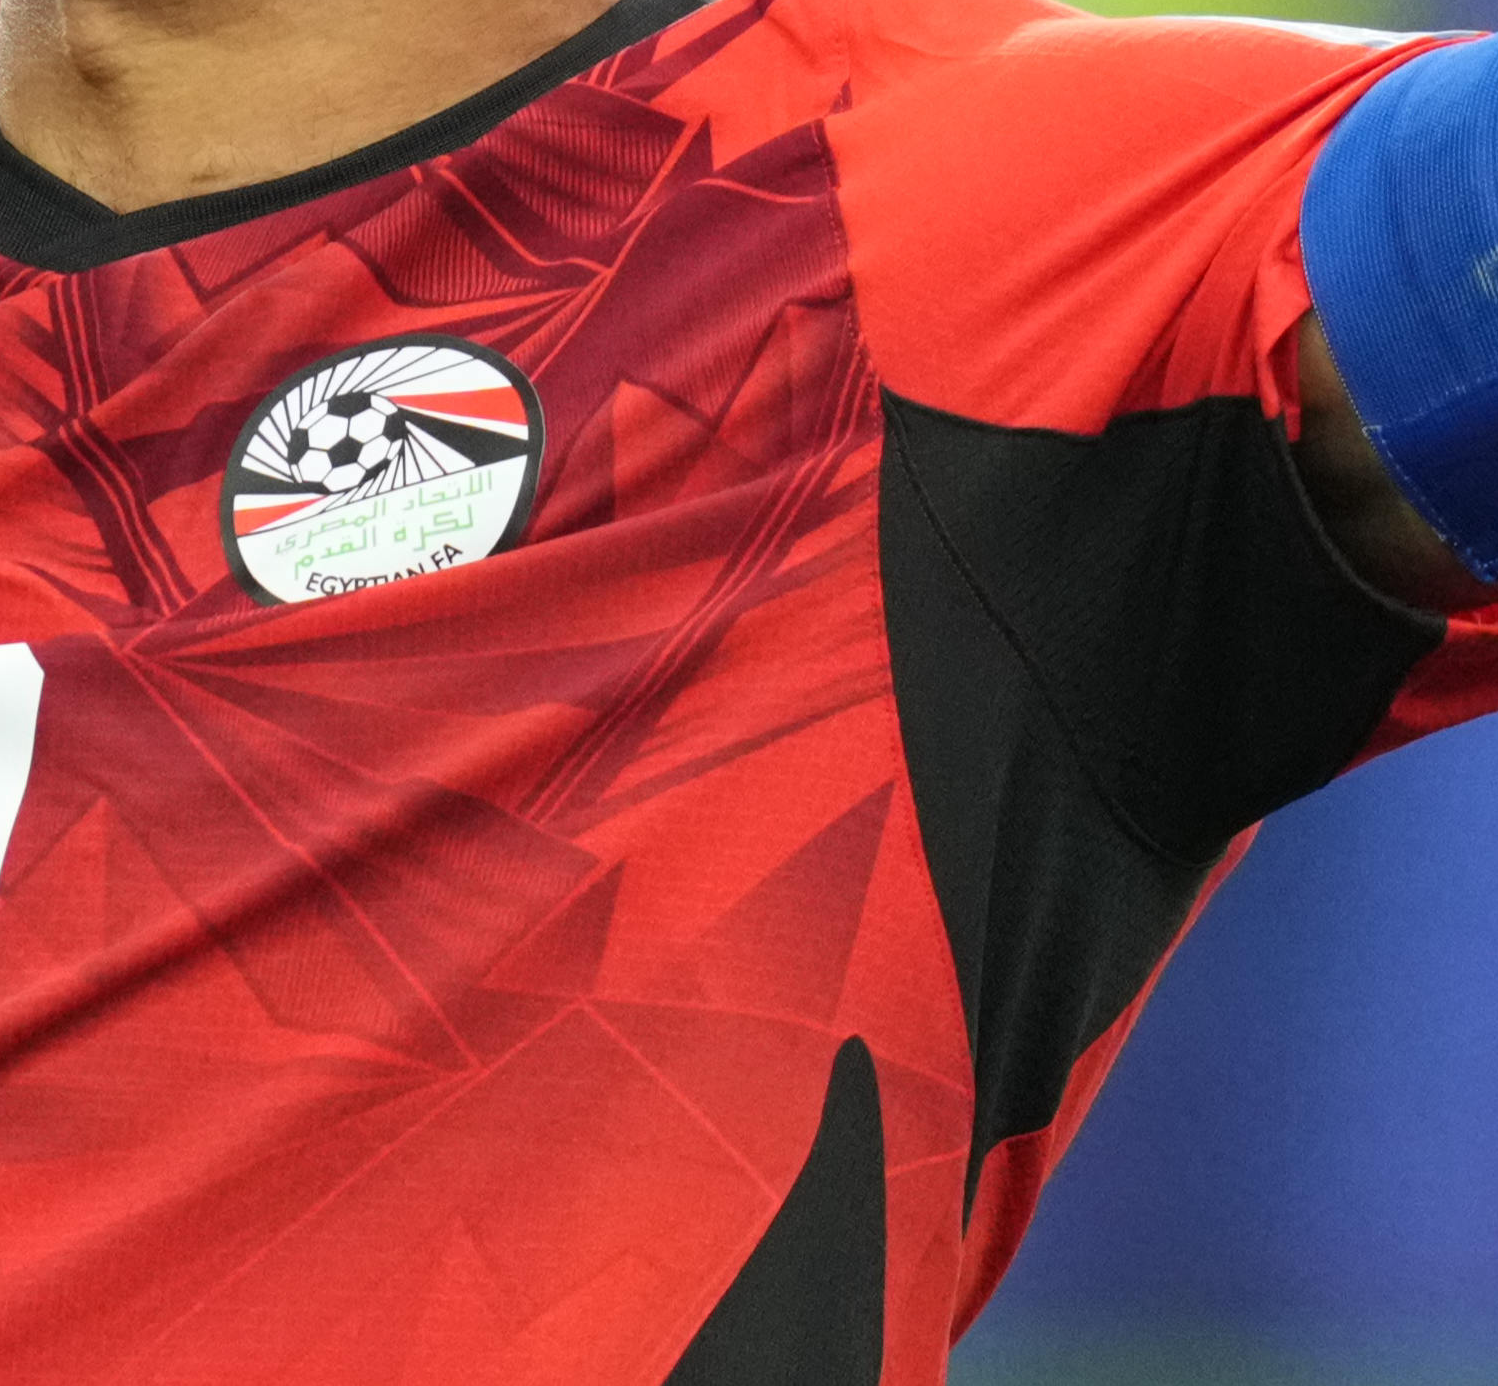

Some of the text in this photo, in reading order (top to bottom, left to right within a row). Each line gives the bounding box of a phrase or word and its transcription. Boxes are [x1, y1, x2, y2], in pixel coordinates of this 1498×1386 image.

[403, 470, 493, 511] الاتحاد
[294, 504, 474, 581] لكرة القدم
[430, 543, 464, 571] FA
